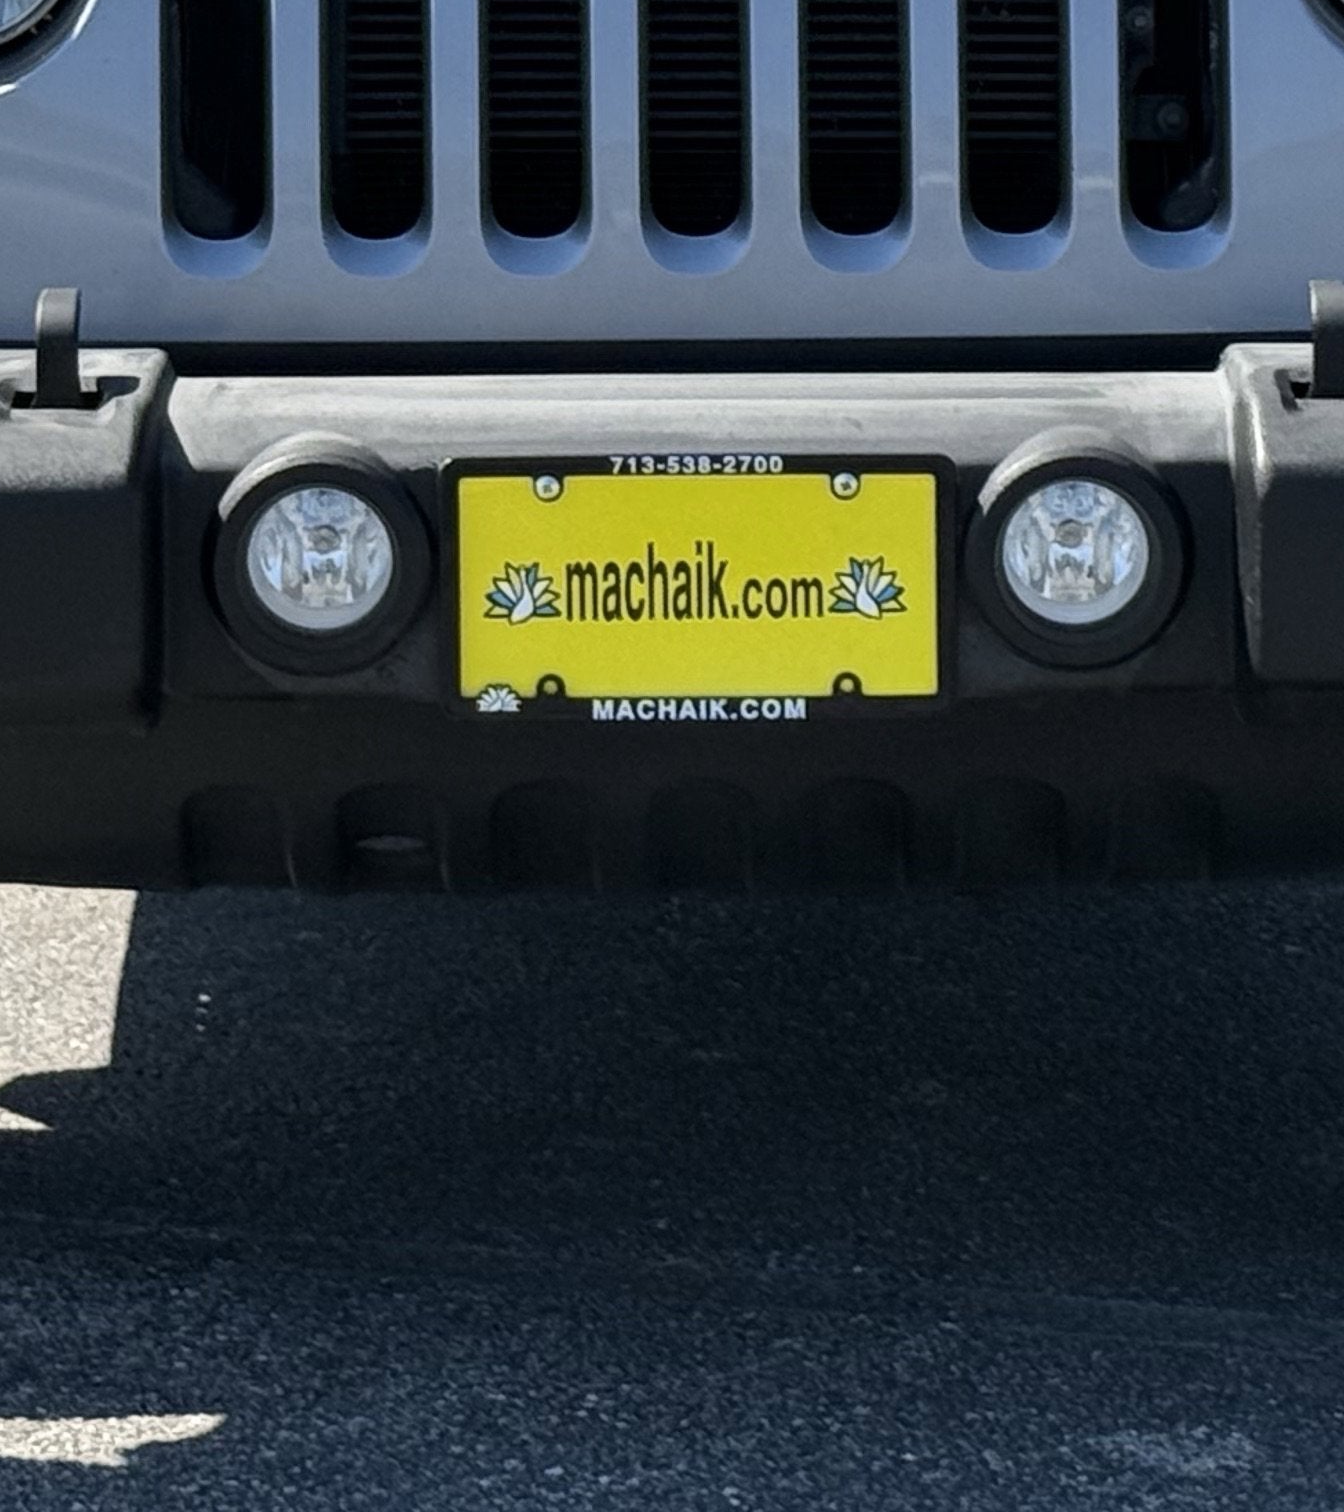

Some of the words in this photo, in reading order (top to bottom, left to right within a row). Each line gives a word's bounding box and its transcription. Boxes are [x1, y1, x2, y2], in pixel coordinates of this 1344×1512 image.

[609, 455, 784, 474] 713-538-2700
[564, 540, 825, 622] machaik.com
[591, 697, 808, 722] MACHAIK.COM
